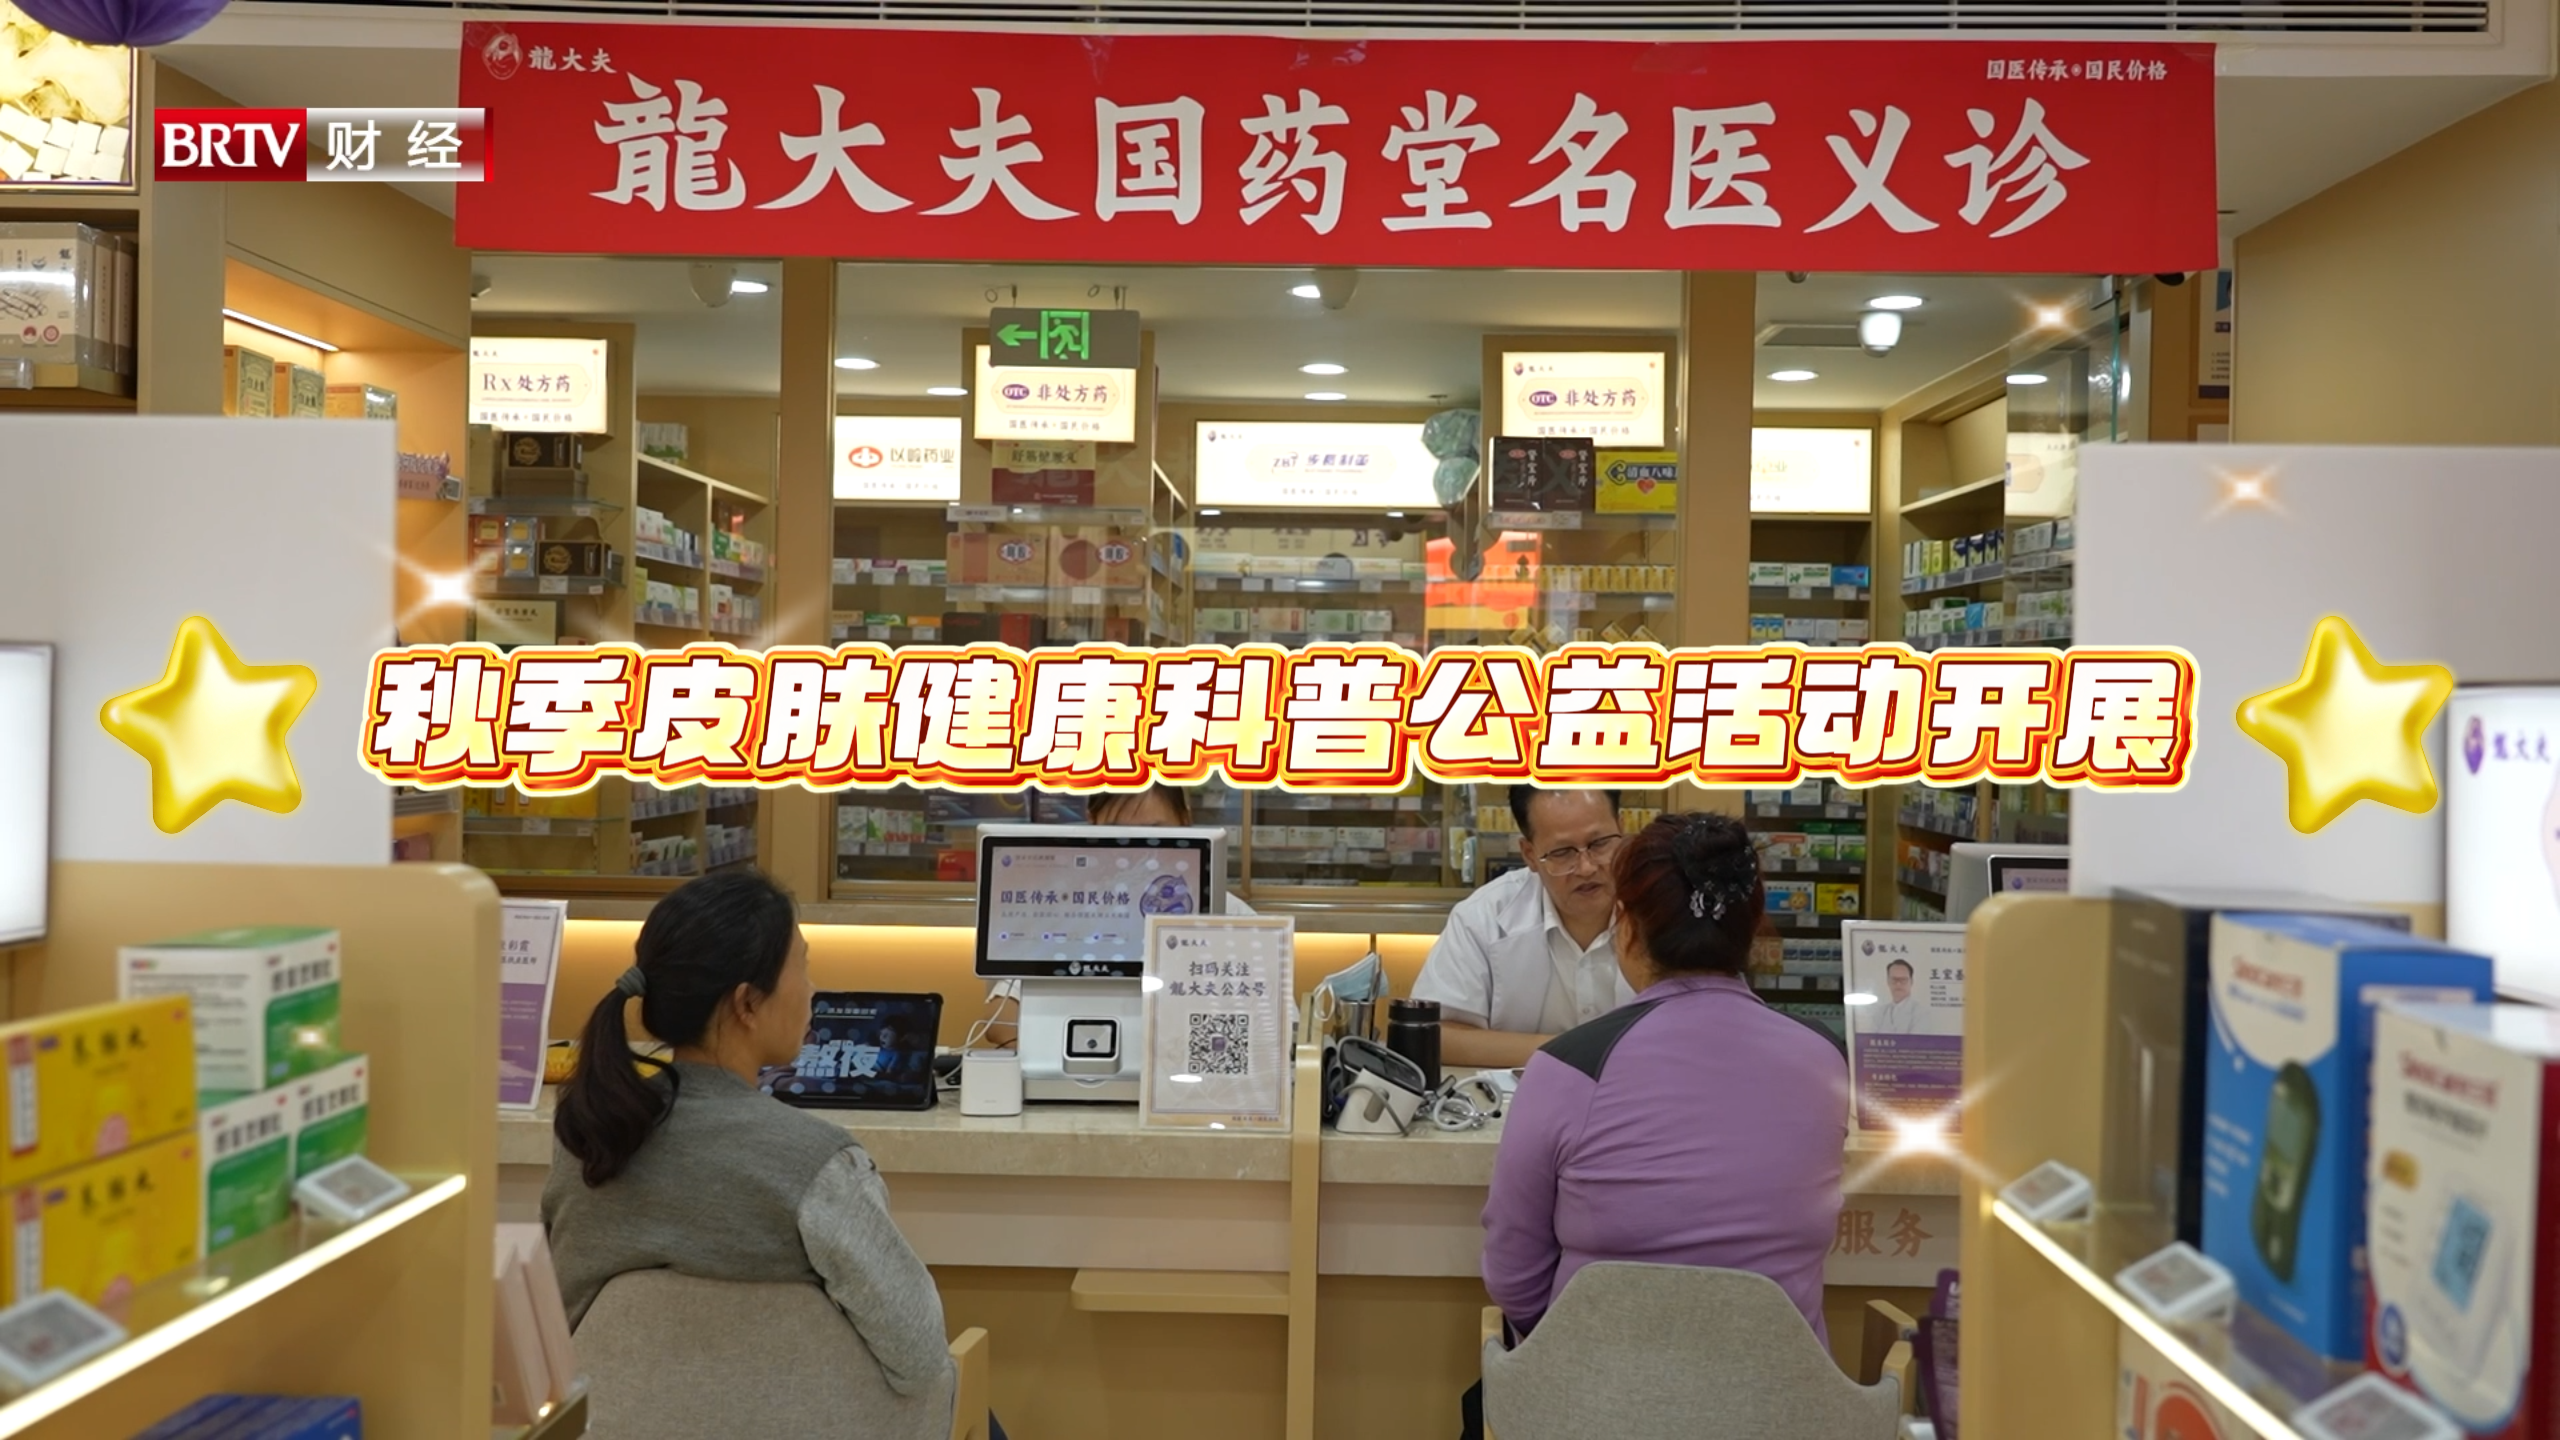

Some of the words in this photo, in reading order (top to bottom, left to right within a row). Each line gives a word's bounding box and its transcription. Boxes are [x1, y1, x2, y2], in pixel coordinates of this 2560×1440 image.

[528, 45, 618, 74] 龍大夫
[591, 74, 2092, 239] 龍大夫国药堂名医义诊
[482, 373, 512, 391] Rx
[517, 374, 571, 393] 处方药
[1037, 384, 1109, 404] 非处方药
[1564, 389, 1637, 408] 非处方药
[1189, 961, 1250, 977] 扫码关注
[1169, 981, 1266, 997] 龍大夫公众号
[1830, 1207, 1934, 1257] 服务
